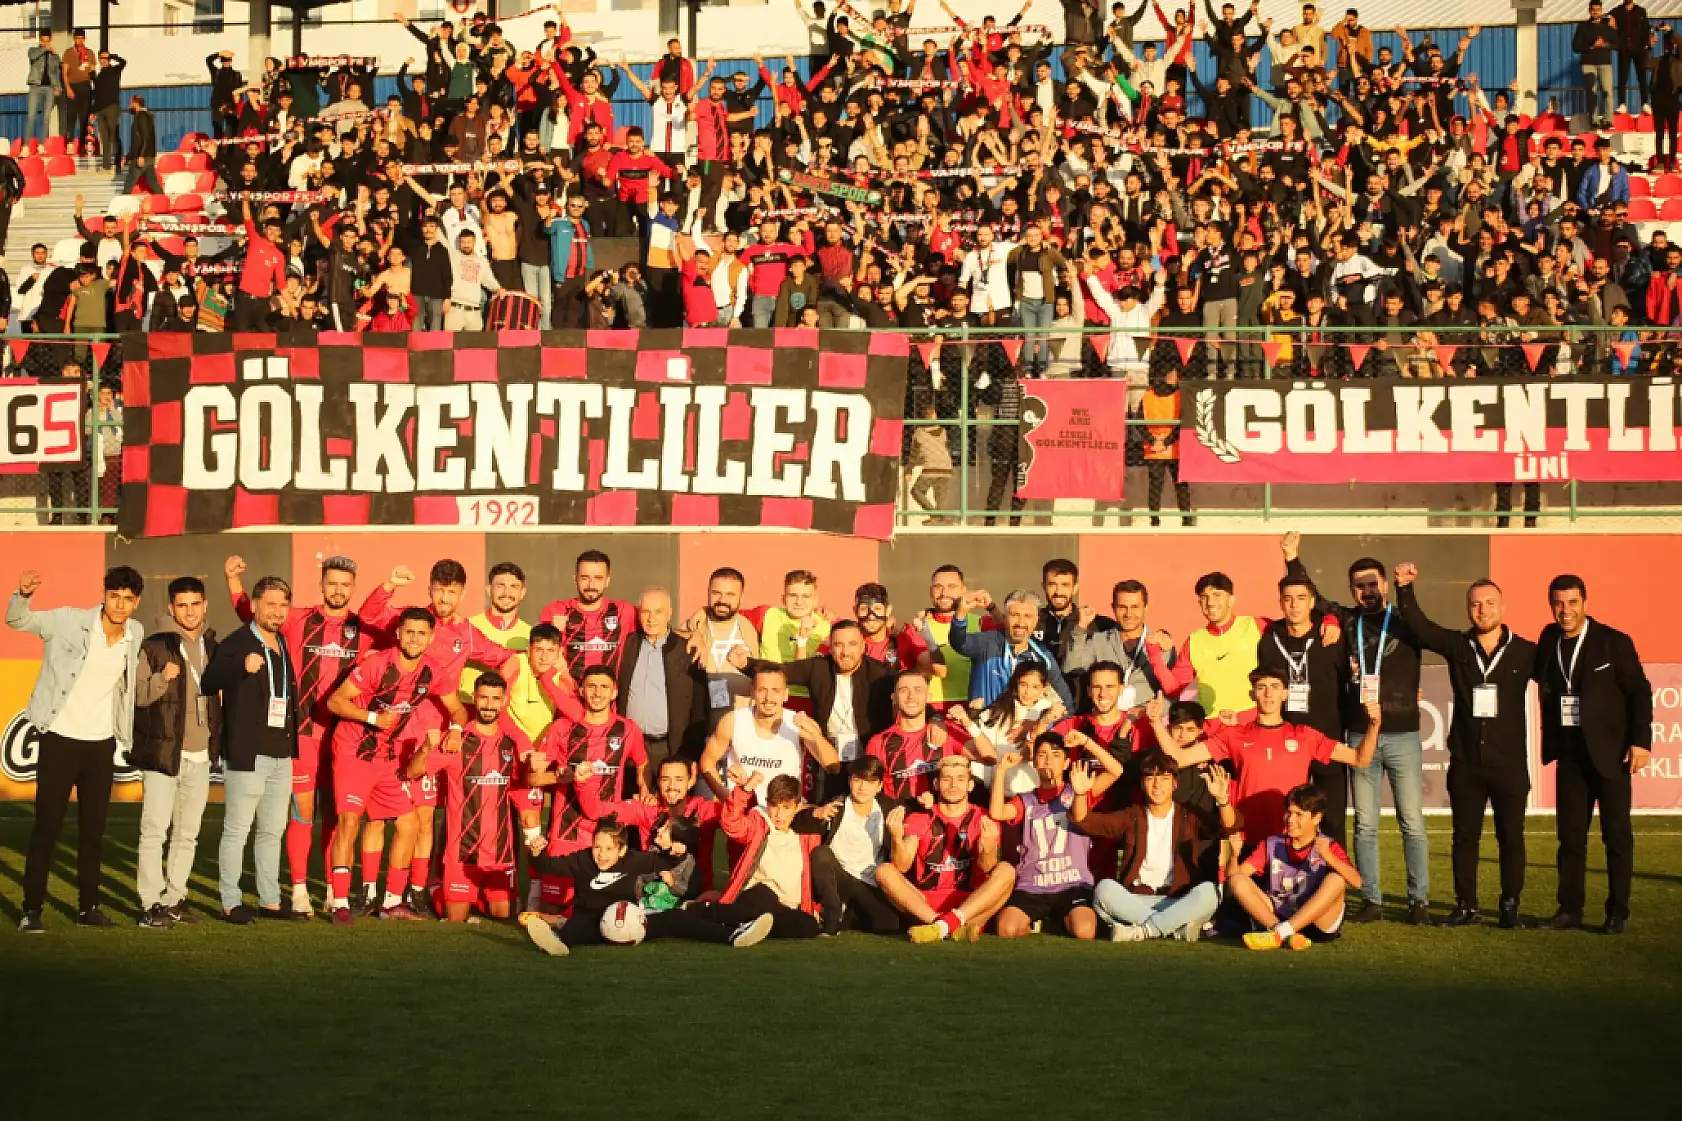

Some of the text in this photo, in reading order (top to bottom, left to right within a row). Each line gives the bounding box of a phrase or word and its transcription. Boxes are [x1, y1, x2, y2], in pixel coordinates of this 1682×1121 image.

[182, 355, 872, 502] GÖLKENTLİLER
[1224, 376, 1682, 455] GÖLKENTLİ
[470, 499, 538, 526] 1982
[1650, 687, 1682, 709] YO
[740, 754, 783, 769] admira
